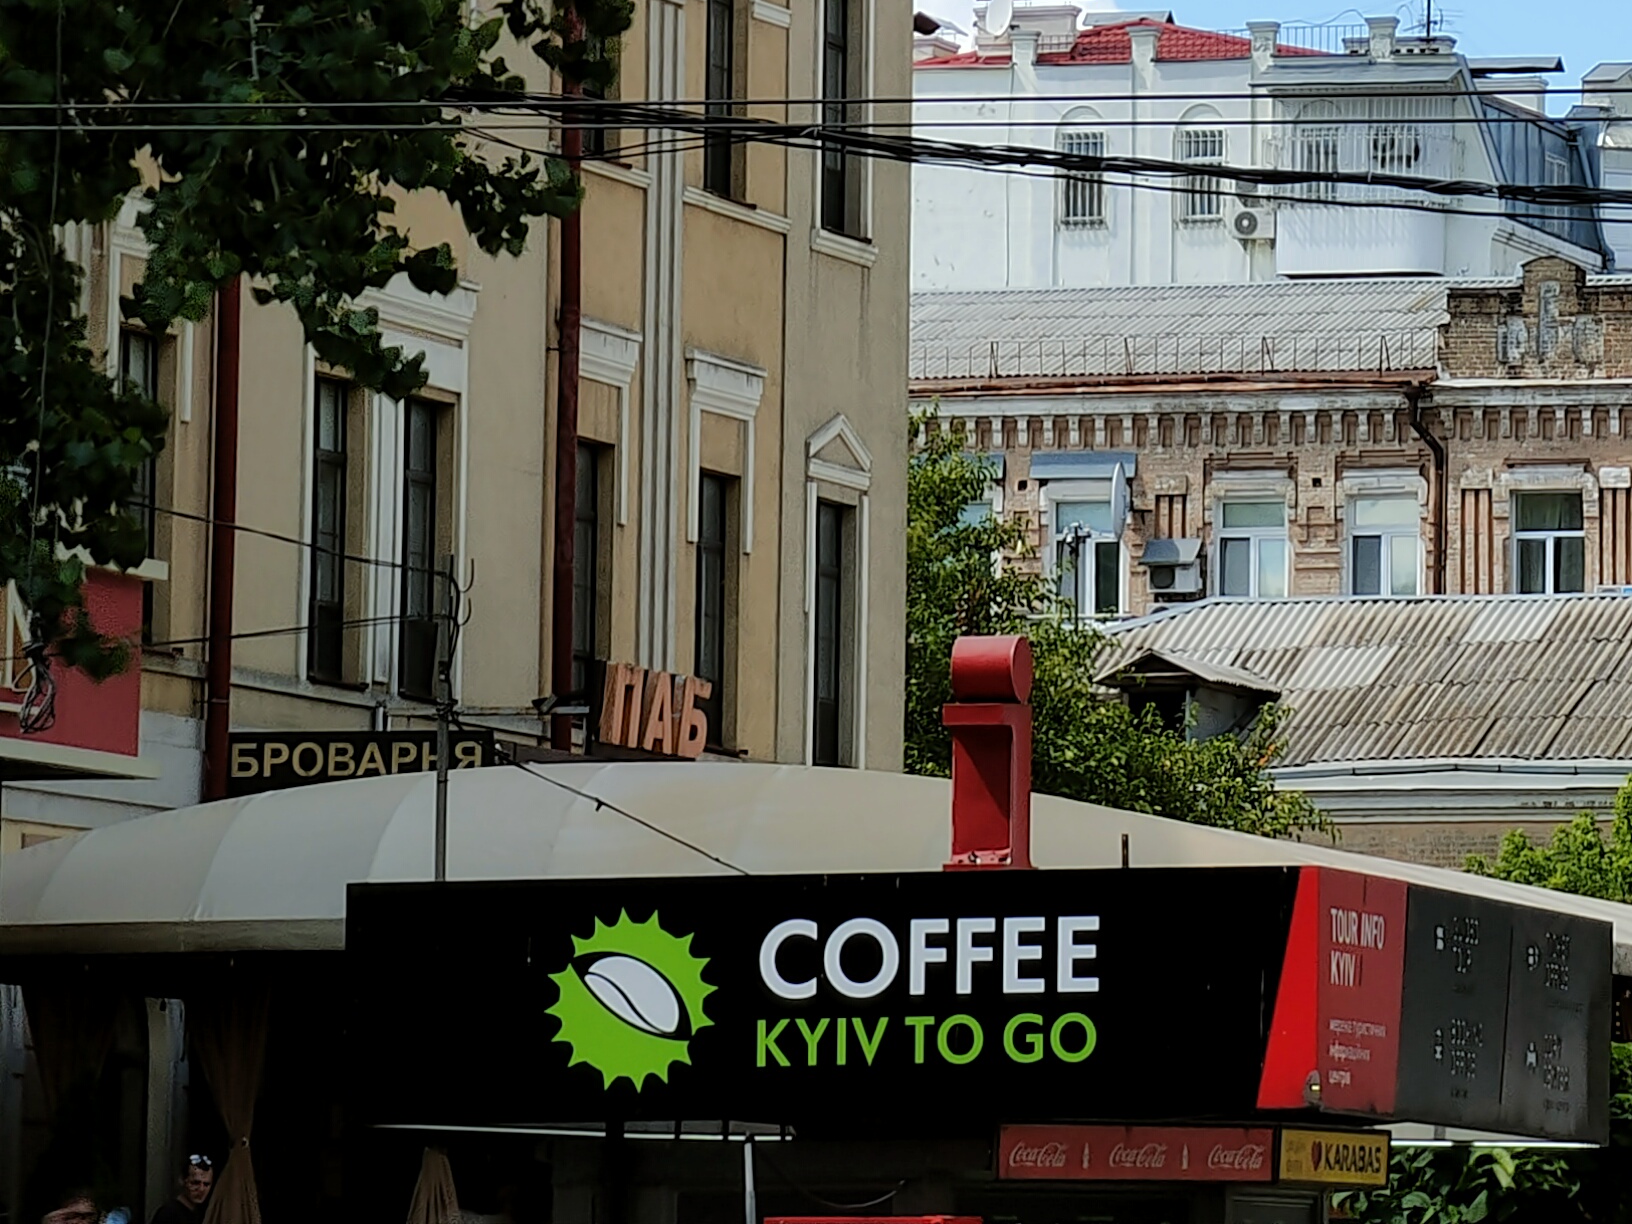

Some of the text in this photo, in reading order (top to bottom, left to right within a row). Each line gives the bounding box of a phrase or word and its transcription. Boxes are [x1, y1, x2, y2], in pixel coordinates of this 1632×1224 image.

[603, 662, 712, 758] ПАБ
[1330, 907, 1385, 950] TOUR INFO
[759, 916, 1100, 1000] COFFEE
[1330, 950, 1356, 987] KYIV
[756, 1012, 1097, 1067] KYIV TO GO
[1324, 1143, 1382, 1174] KARABAS
